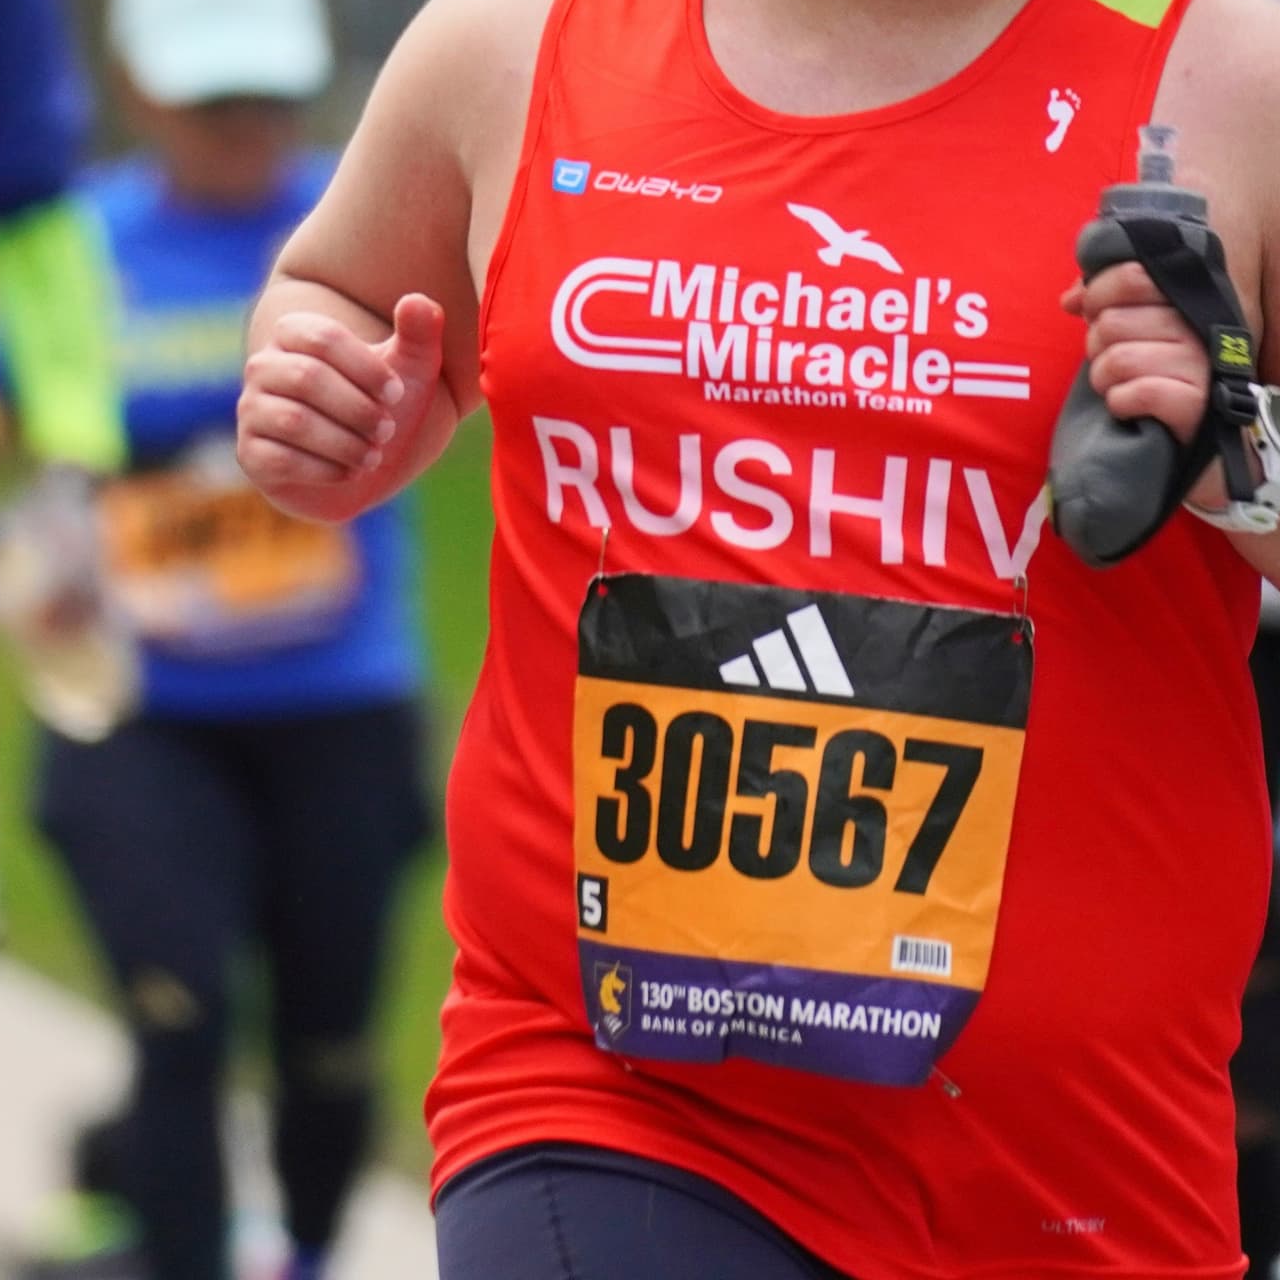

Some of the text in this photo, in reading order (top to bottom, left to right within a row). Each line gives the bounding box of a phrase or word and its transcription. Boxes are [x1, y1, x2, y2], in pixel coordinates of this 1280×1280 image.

[650, 259, 989, 338] Michael's
[687, 320, 951, 395] Miracle
[704, 381, 933, 415] Marathon Team
[532, 416, 1052, 579] RUSHIV
[595, 703, 985, 896] 30567
[581, 879, 602, 926] 5
[641, 1014, 804, 1045] BANK OF AMERICA
[687, 983, 785, 1021] BOSTON
[790, 998, 942, 1040] MARATHON
